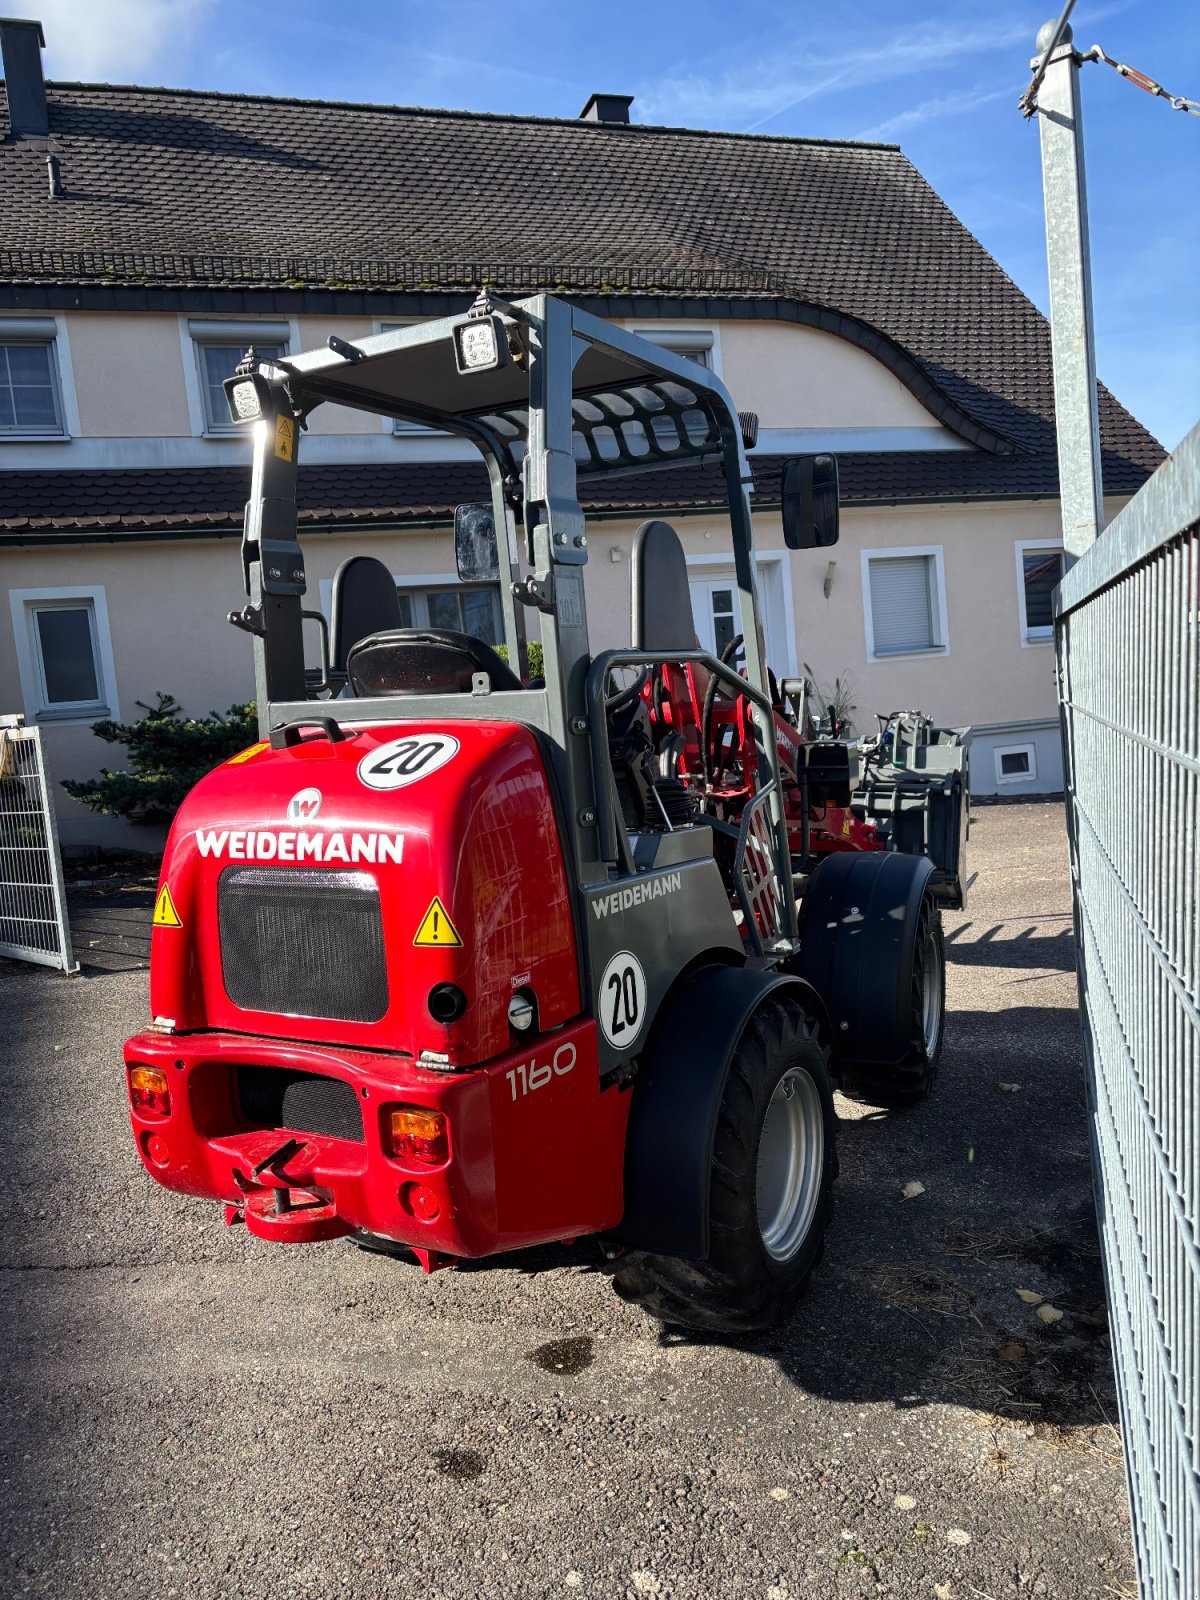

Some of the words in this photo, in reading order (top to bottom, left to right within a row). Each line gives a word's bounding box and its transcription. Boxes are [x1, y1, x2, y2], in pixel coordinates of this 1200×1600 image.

[368, 740, 444, 775] 20
[195, 829, 405, 864] WEIDEMANN
[591, 871, 682, 920] WEIDEMANN
[512, 973, 531, 986] Diesel
[608, 966, 638, 1036] 20
[505, 1041, 577, 1102] 1160
